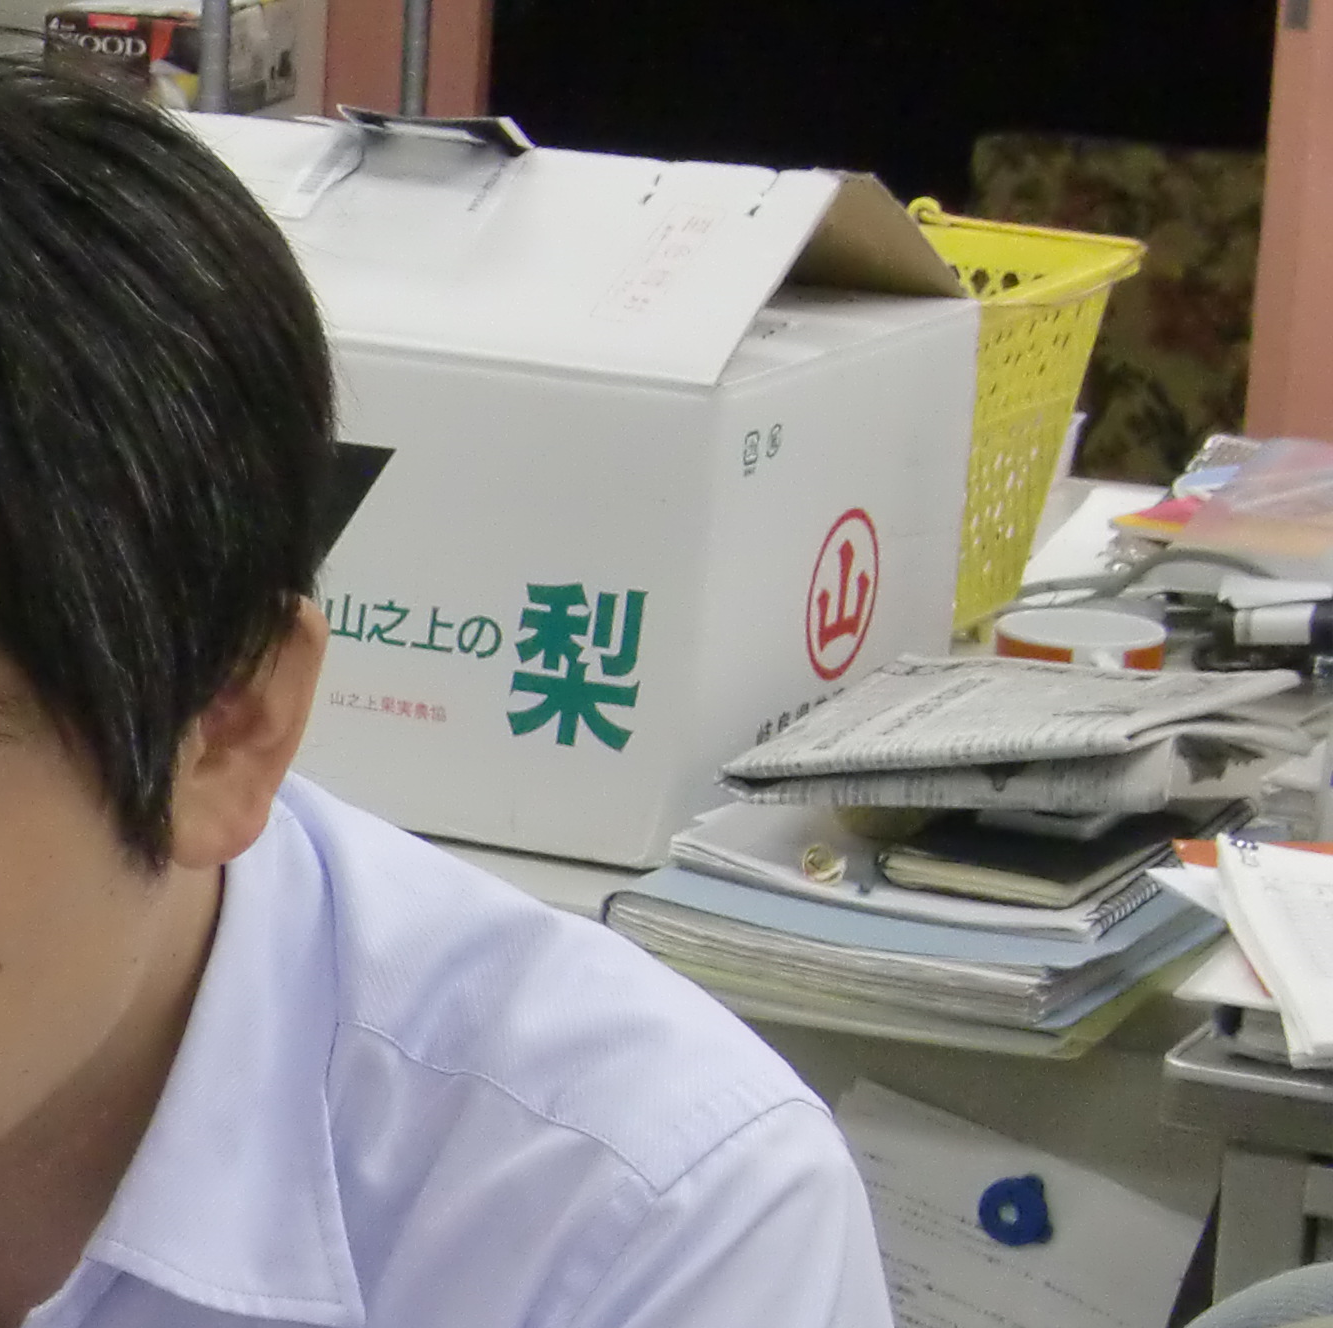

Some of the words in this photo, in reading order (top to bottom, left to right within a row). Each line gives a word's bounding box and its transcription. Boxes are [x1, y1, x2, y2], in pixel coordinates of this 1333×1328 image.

[325, 594, 503, 659] 山之上の
[506, 581, 649, 752] 梨
[818, 539, 869, 652] 山
